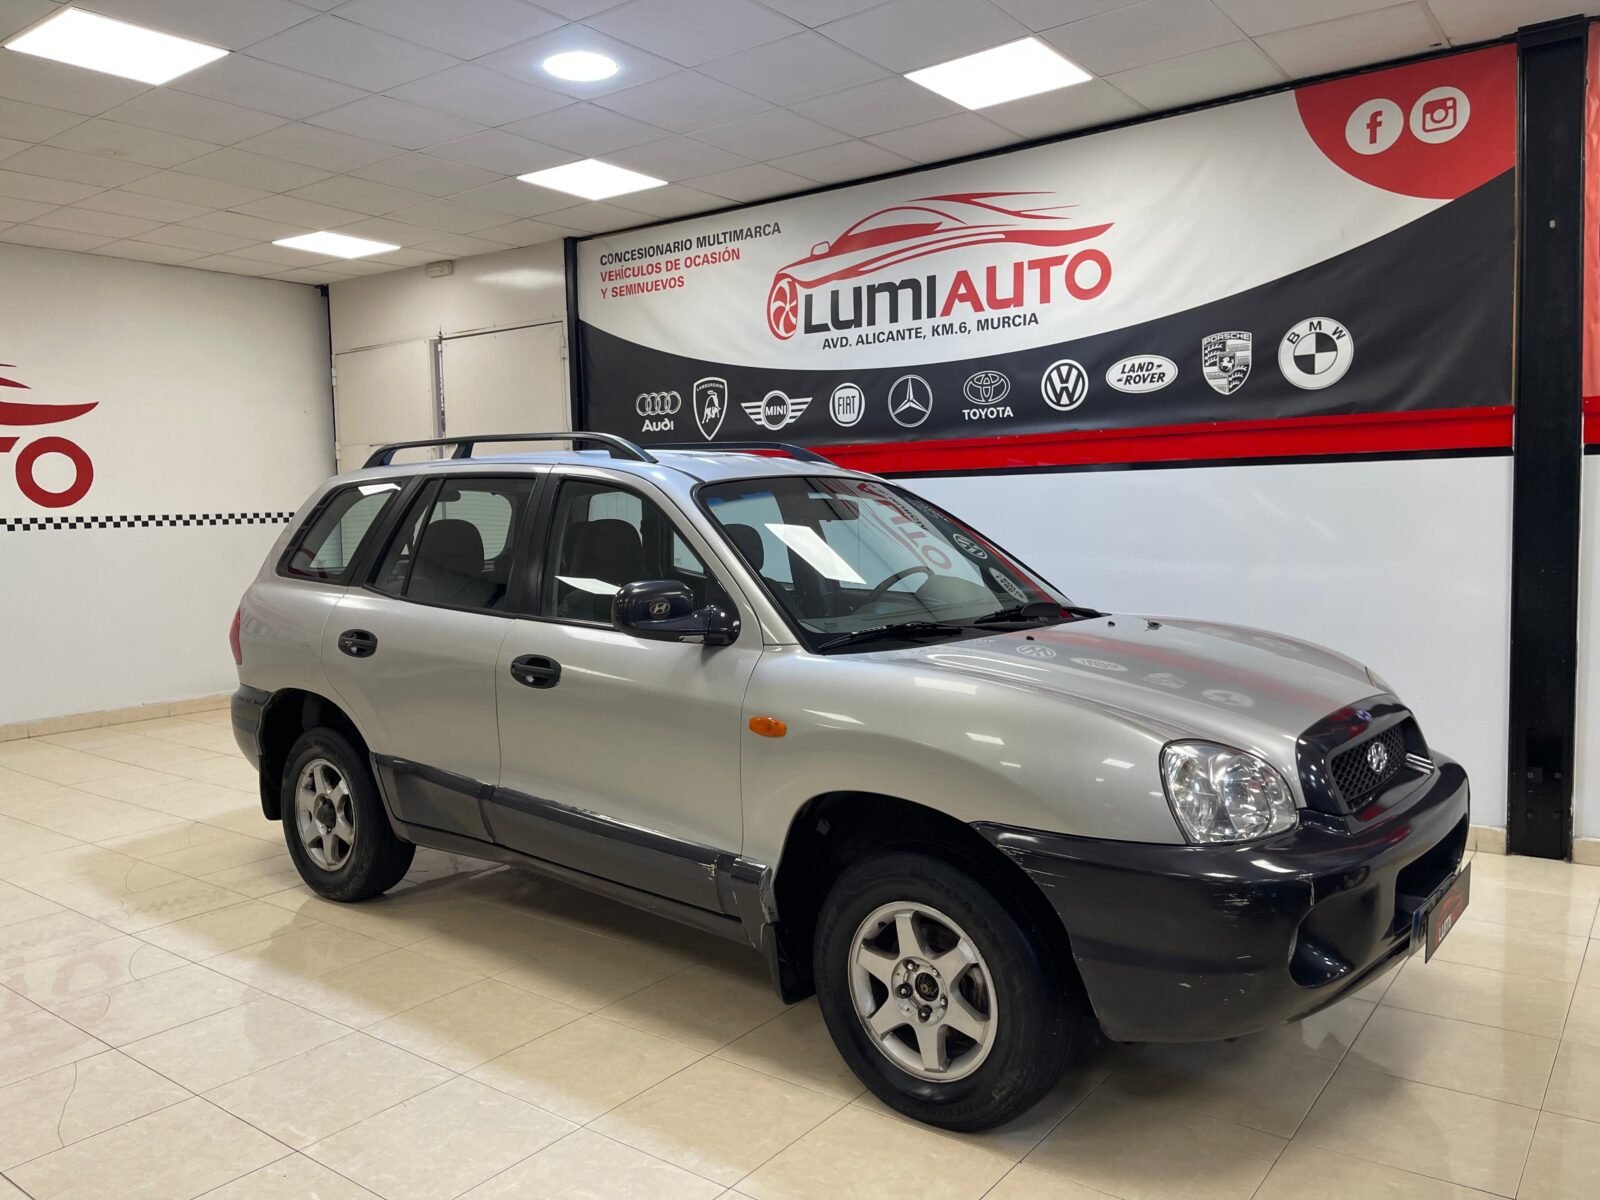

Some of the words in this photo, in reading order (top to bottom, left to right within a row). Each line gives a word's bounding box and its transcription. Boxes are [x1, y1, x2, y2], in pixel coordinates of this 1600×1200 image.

[600, 238, 693, 266] CONCESIONARIO
[696, 221, 782, 249] MULTIMARCA
[600, 262, 662, 283] VEHÍCULOS
[665, 258, 681, 273] DE
[684, 246, 741, 269] OCASIÓN
[600, 288, 608, 299] Y
[611, 276, 685, 298] SEMINUEVOS
[822, 335, 852, 350] AVD.
[855, 326, 927, 347] ALICANTE,
[931, 321, 972, 338] KM.6,
[976, 312, 1039, 332] MURCIA
[1203, 333, 1250, 345] PORSCHE
[1287, 320, 1347, 345] BMW
[696, 382, 725, 392] LAMBORGHINI
[765, 404, 787, 417] MINI
[837, 395, 856, 416] FIAT
[962, 406, 1014, 421] TOYOTA
[641, 418, 675, 433] Audi
